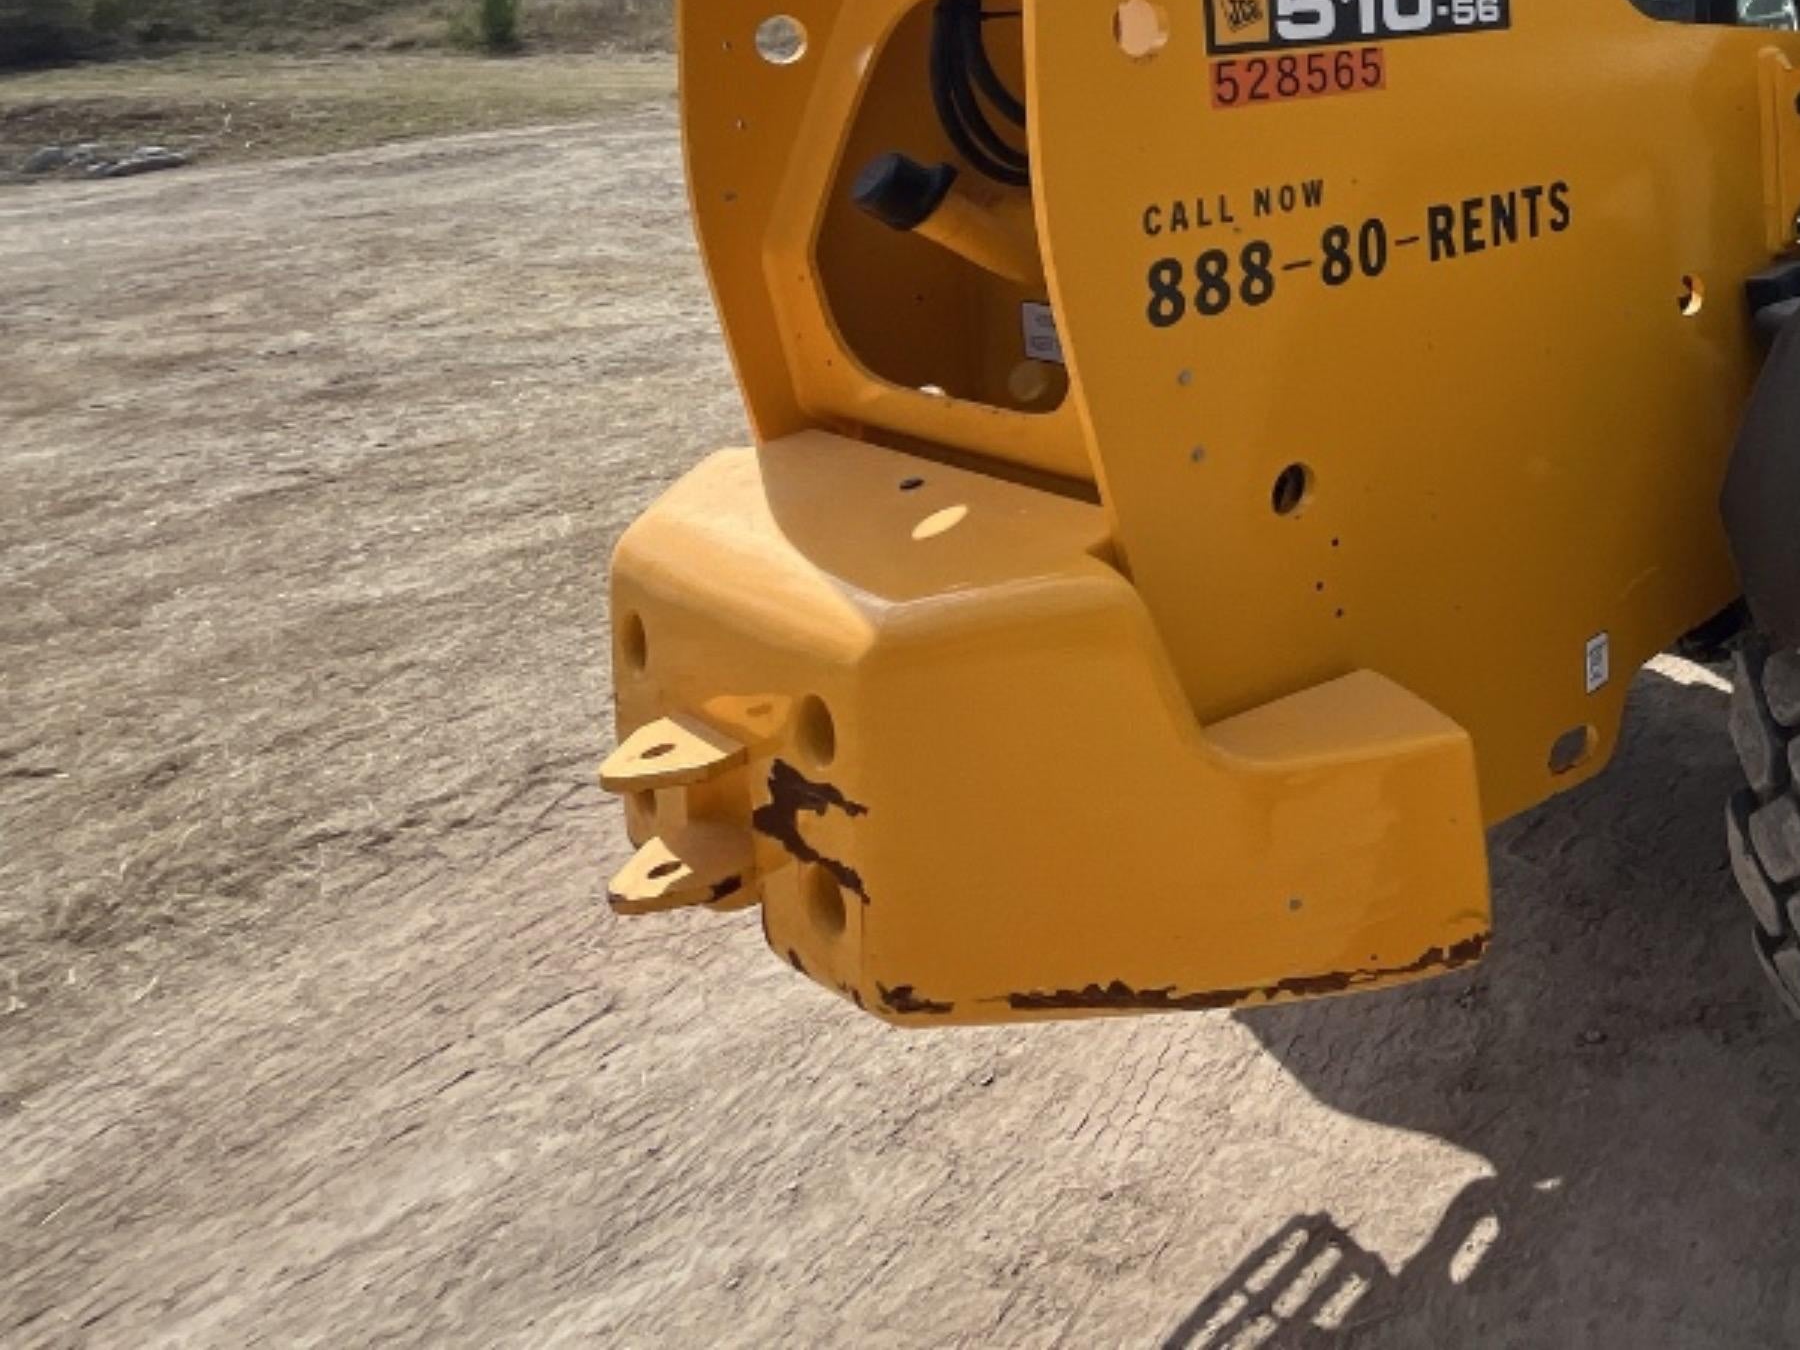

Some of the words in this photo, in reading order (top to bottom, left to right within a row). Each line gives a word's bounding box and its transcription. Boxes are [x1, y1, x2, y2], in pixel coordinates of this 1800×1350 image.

[1215, 48, 1381, 103] 528565
[1142, 194, 1234, 236] CALL
[1253, 179, 1324, 217] NOW
[1146, 181, 1571, 328] 888-80-RENTS
